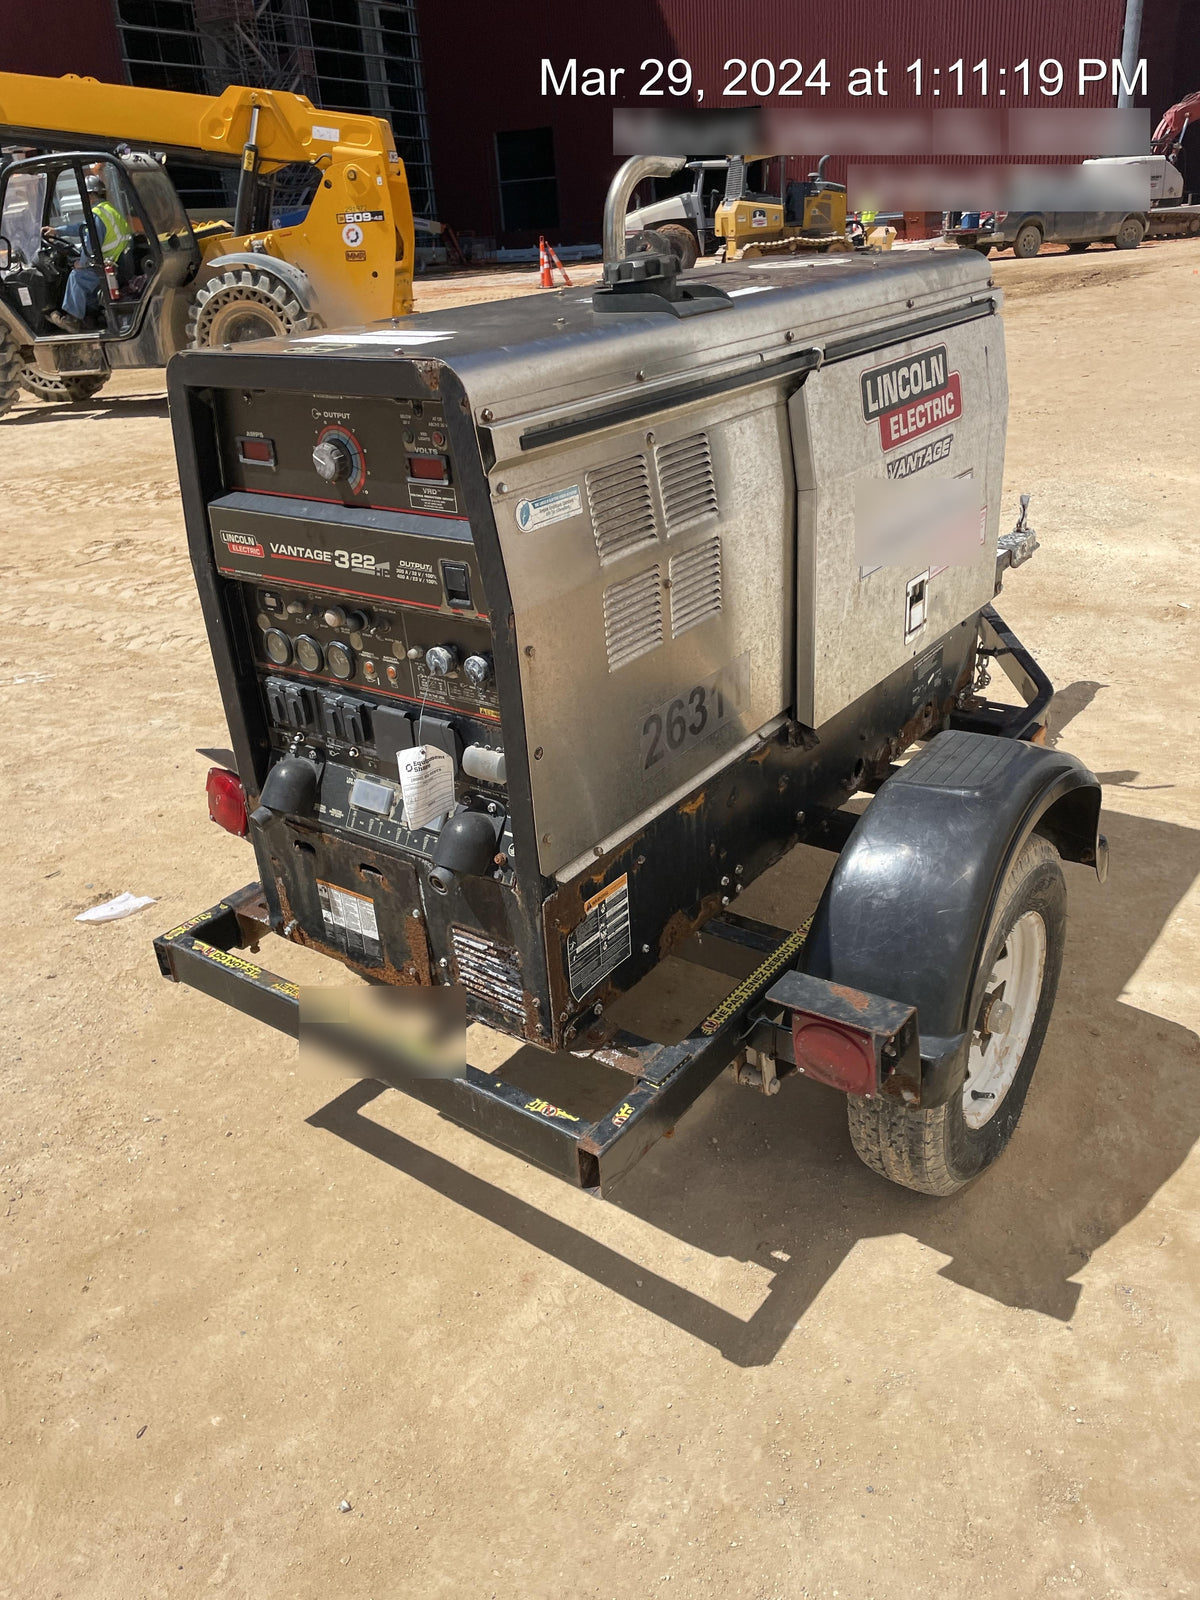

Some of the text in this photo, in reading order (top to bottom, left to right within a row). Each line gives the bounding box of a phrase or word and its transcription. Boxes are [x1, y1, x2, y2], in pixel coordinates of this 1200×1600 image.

[866, 353, 945, 413] LINCOLN
[323, 411, 351, 419] OUTPUT
[889, 391, 955, 441] ELECTRIC
[415, 447, 438, 455] VOLTS
[886, 437, 951, 479] VANTAGE
[222, 533, 255, 546] LINCOLN
[232, 544, 261, 555] ELECTRIC
[270, 542, 333, 562] VANTAGE
[334, 550, 376, 570] 322
[400, 560, 430, 570] OUTPUT
[413, 755, 445, 767] Equipment
[213, 952, 228, 961] DO
[226, 957, 247, 970] NOT
[714, 935, 803, 1020] NE PAS TENEZ DEBOUT ICI
